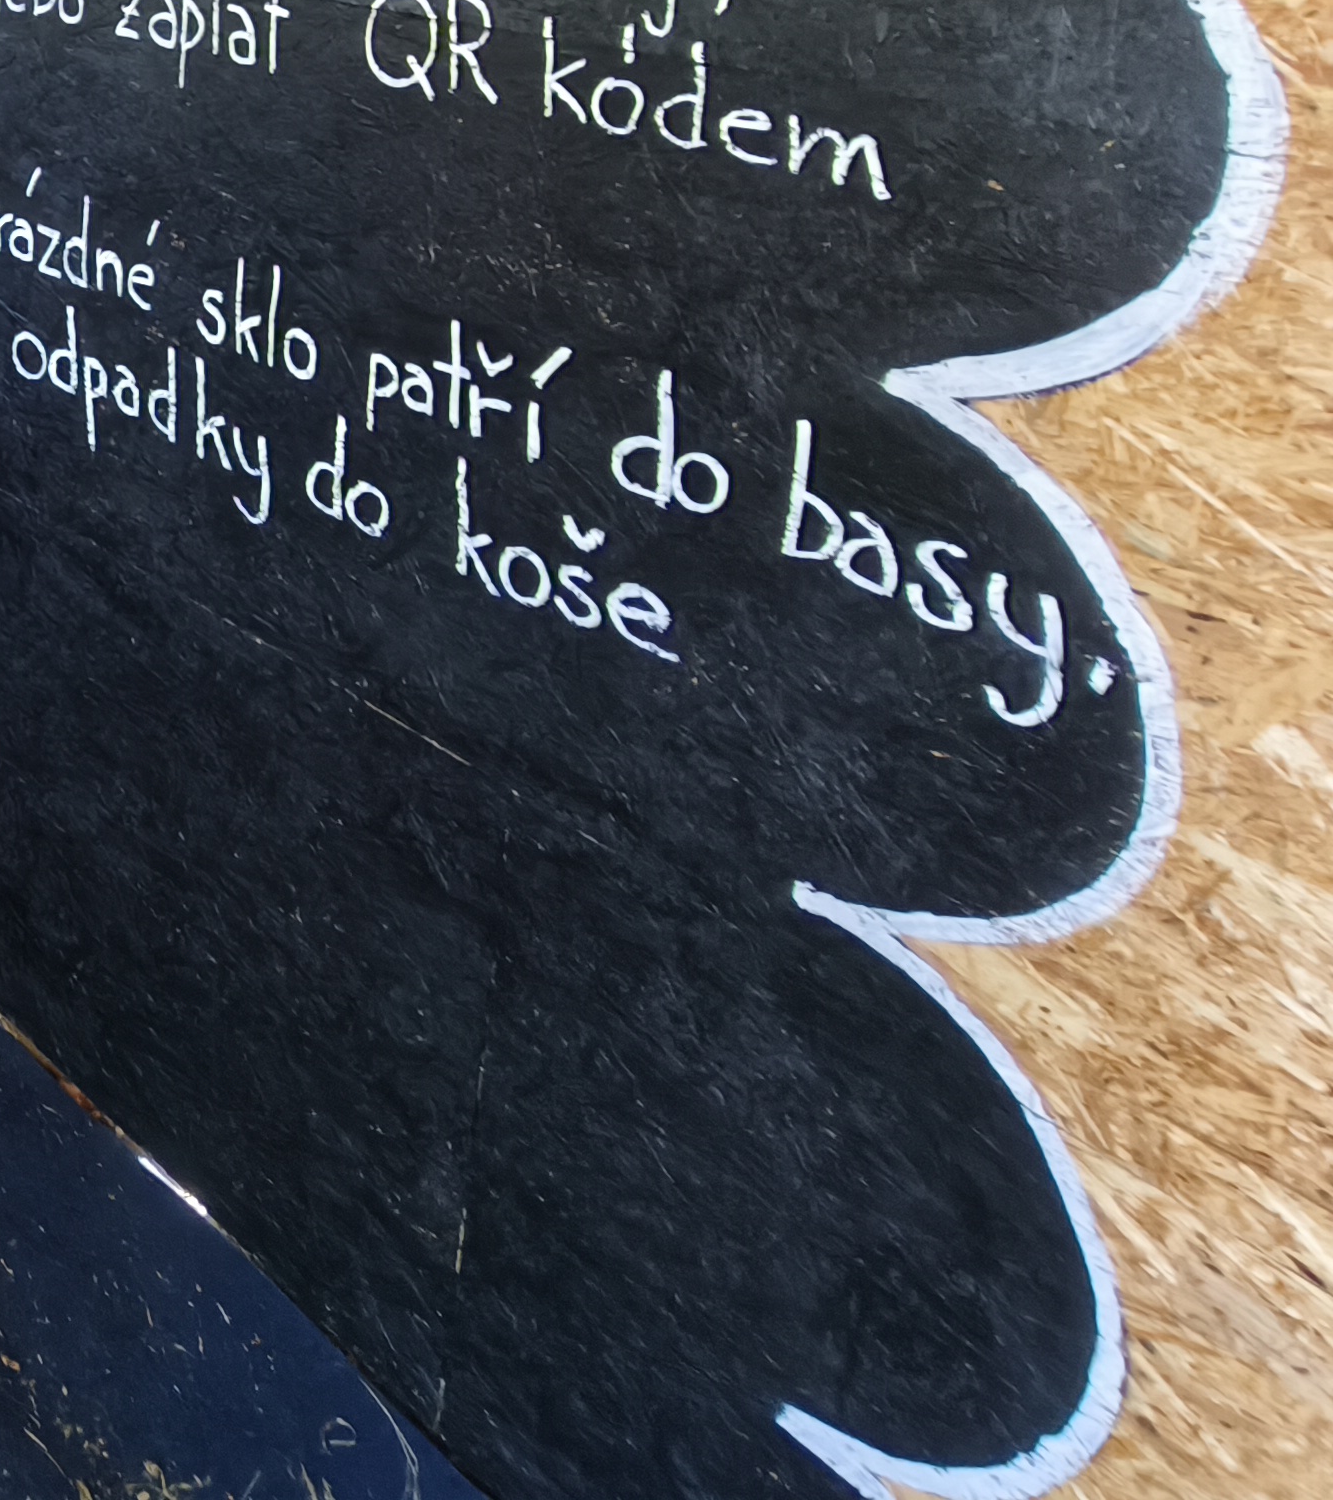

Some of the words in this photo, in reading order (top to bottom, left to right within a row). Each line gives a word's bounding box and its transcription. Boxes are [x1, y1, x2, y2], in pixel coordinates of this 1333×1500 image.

[543, 16, 891, 201] kódem
[11, 305, 272, 525] odpadky
[305, 414, 390, 537] do
[455, 455, 680, 662] koše
[196, 257, 317, 380] sklo
[366, 318, 572, 464] patří
[611, 369, 730, 514] do
[780, 419, 1116, 728] basy.
